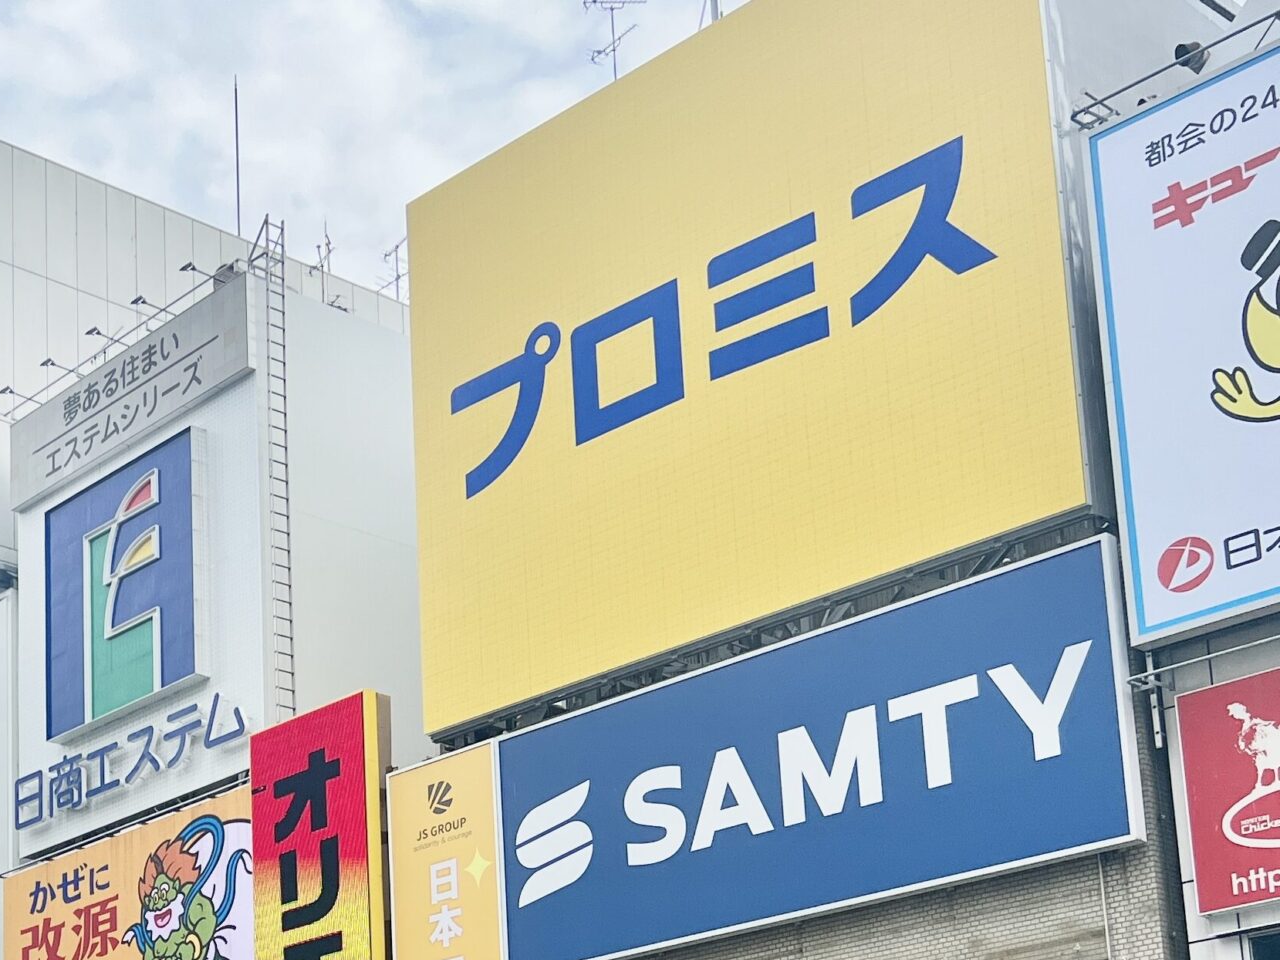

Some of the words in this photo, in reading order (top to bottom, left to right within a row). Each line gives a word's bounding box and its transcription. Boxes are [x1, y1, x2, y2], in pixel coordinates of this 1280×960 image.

[451, 135, 999, 499] プロミス
[46, 355, 203, 478] エステムシリーズ
[63, 332, 180, 427] 夢ある住まい
[15, 692, 246, 831] 日商エステム
[622, 640, 1093, 866] SAMTY
[29, 863, 111, 915] かぜに
[416, 829, 428, 842] JS
[430, 817, 467, 837] GROUP
